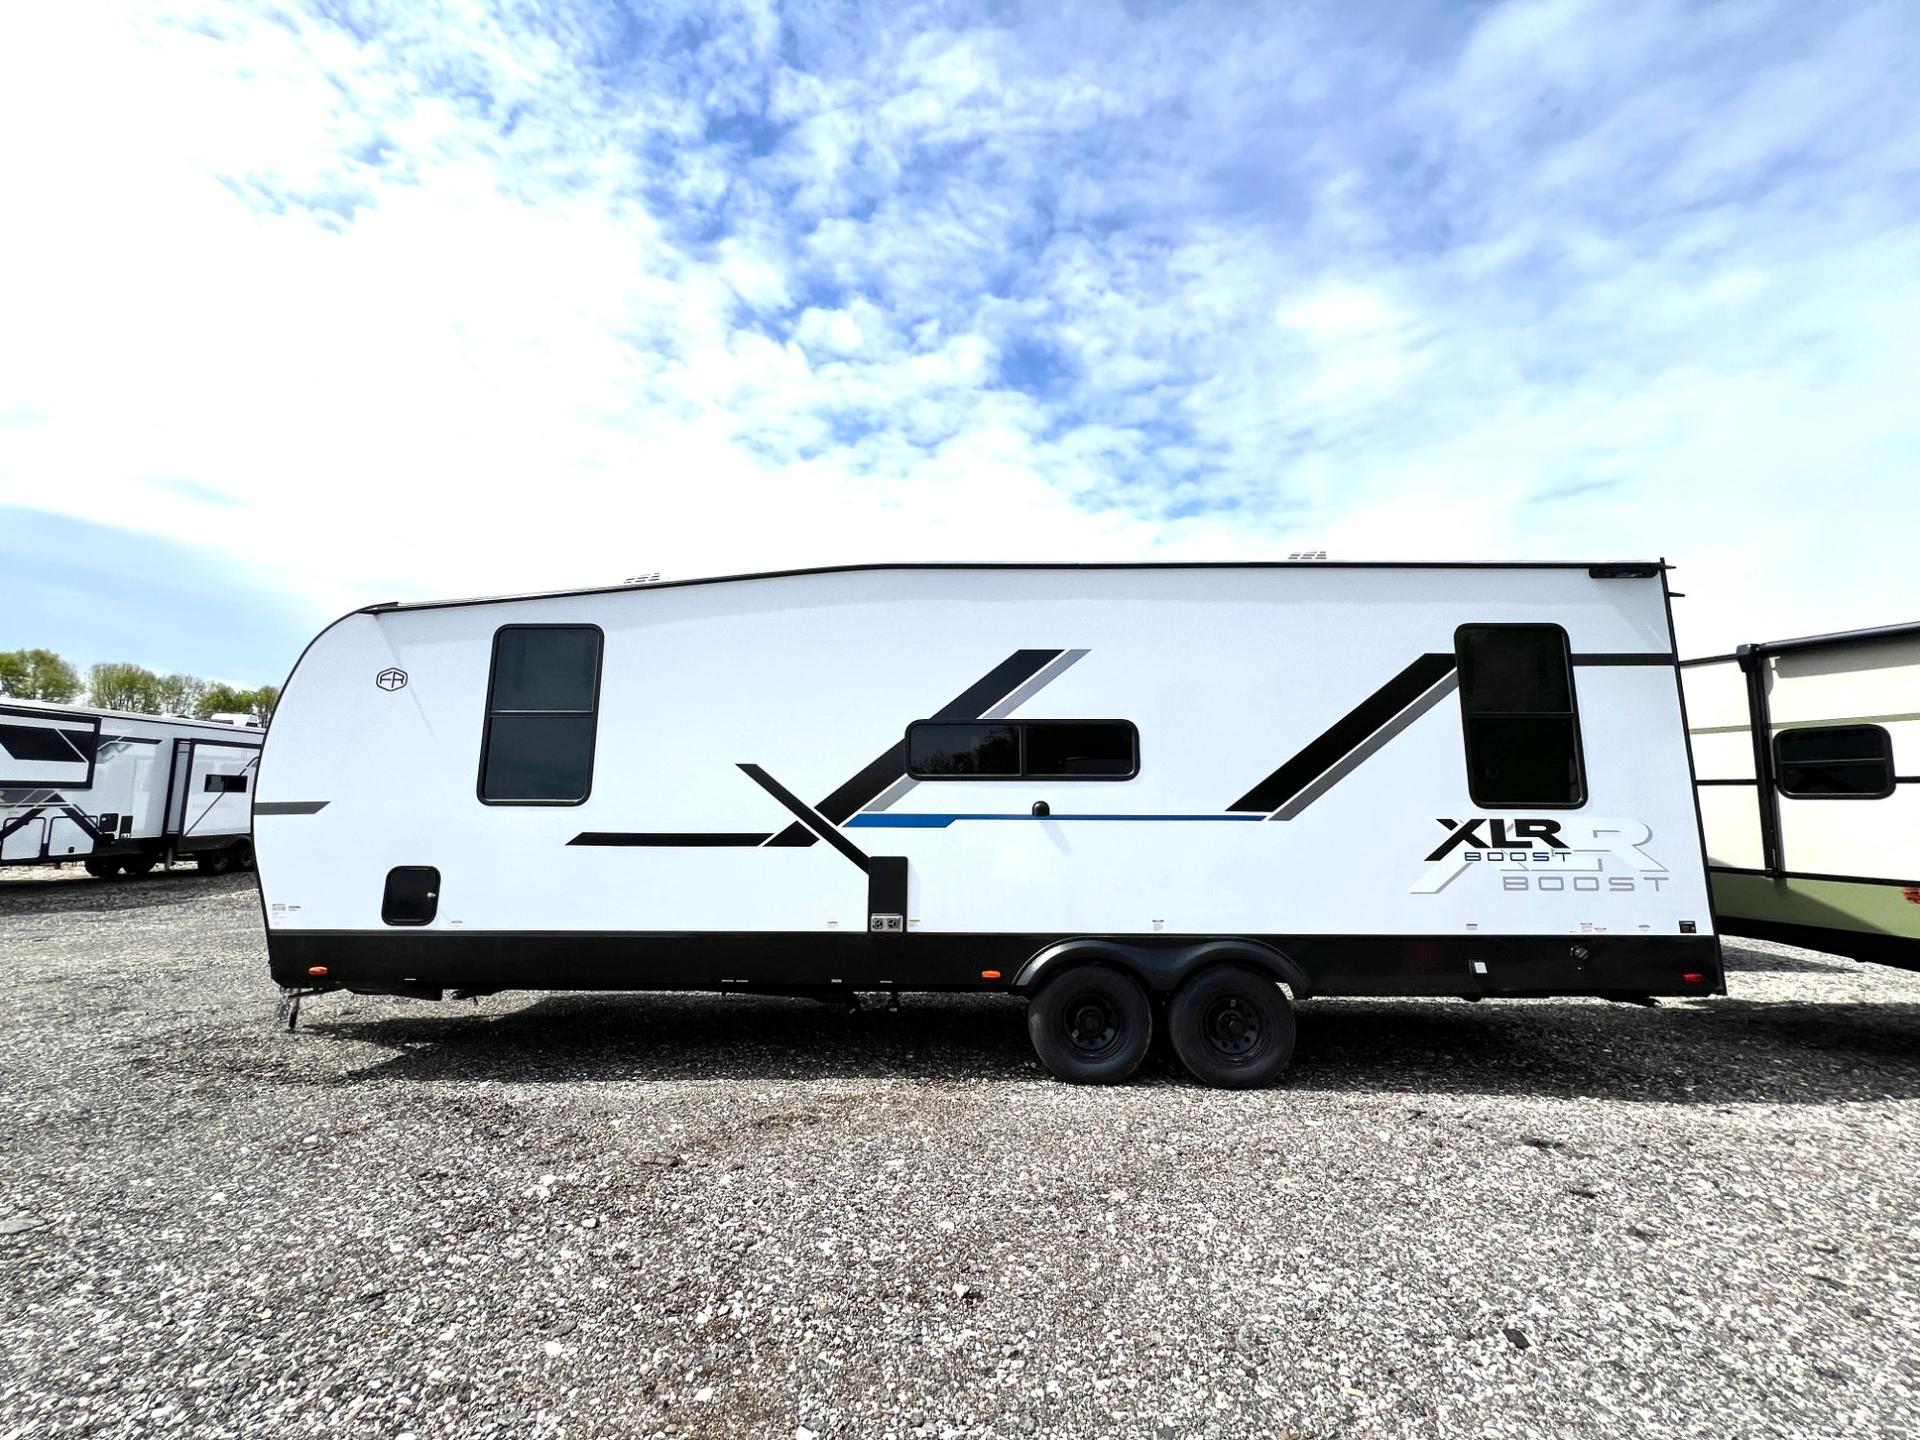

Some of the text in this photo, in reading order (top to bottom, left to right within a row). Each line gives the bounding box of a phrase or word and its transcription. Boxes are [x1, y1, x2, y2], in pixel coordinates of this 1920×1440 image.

[1424, 818, 1570, 862] XLR
[1464, 851, 1572, 862] BOOST
[1503, 876, 1669, 892] BOOST
